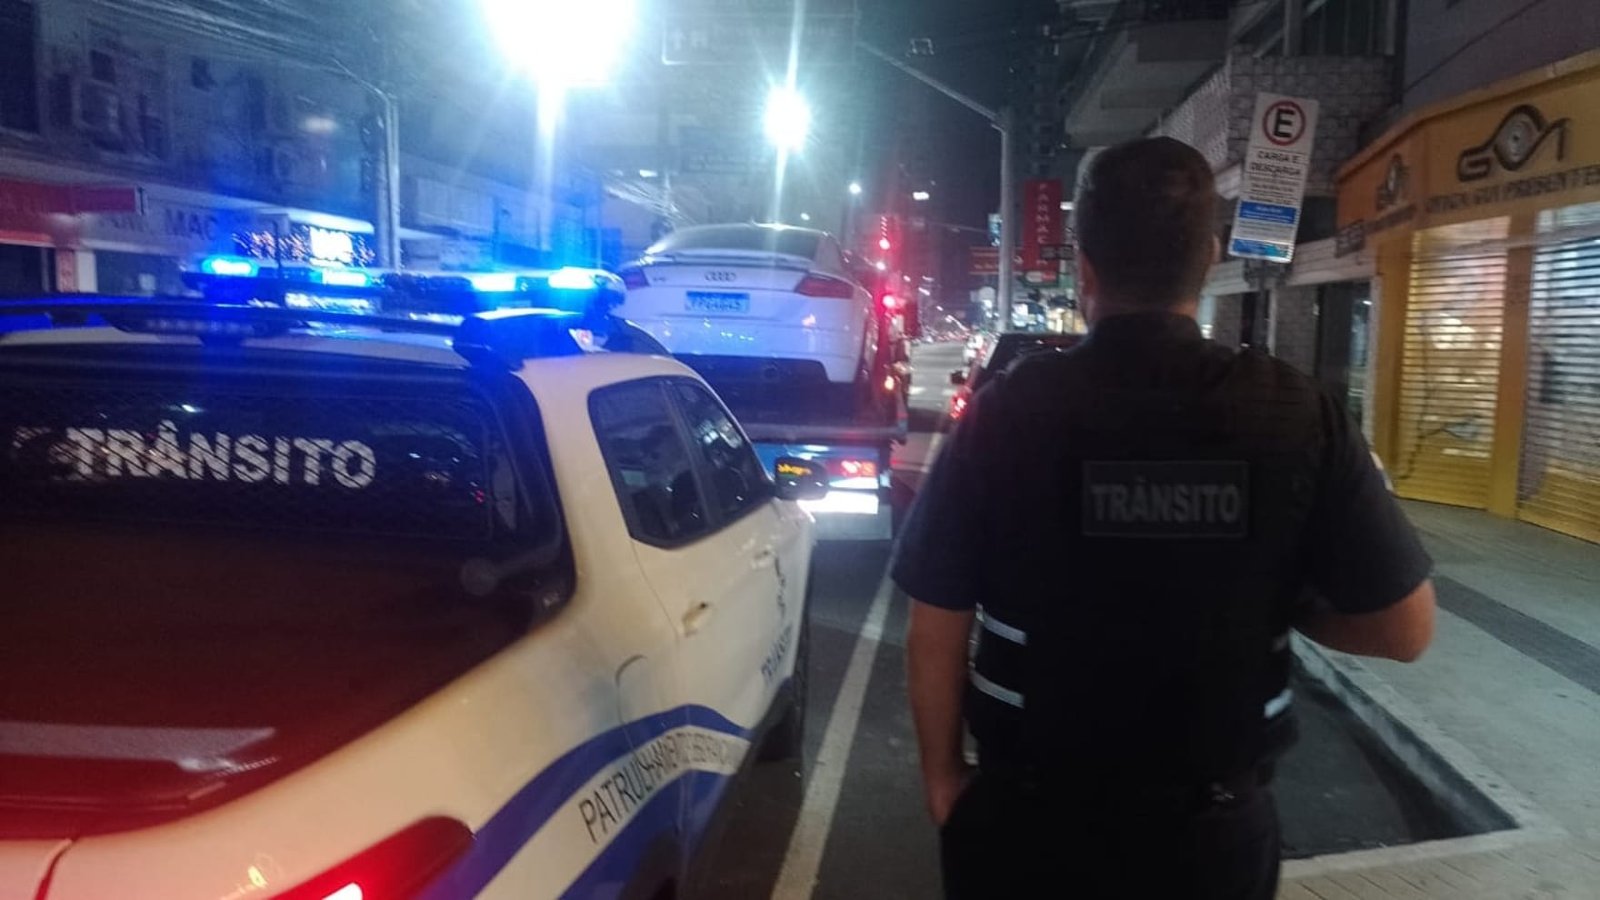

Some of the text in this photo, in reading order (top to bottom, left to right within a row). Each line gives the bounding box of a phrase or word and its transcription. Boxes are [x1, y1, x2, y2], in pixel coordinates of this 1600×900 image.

[1273, 107, 1296, 138] E
[1257, 150, 1290, 163] CARGA
[1034, 182, 1051, 267] FARMACA
[65, 419, 376, 488] TRÂNSITO
[1090, 474, 1240, 523] TRÂNSITO
